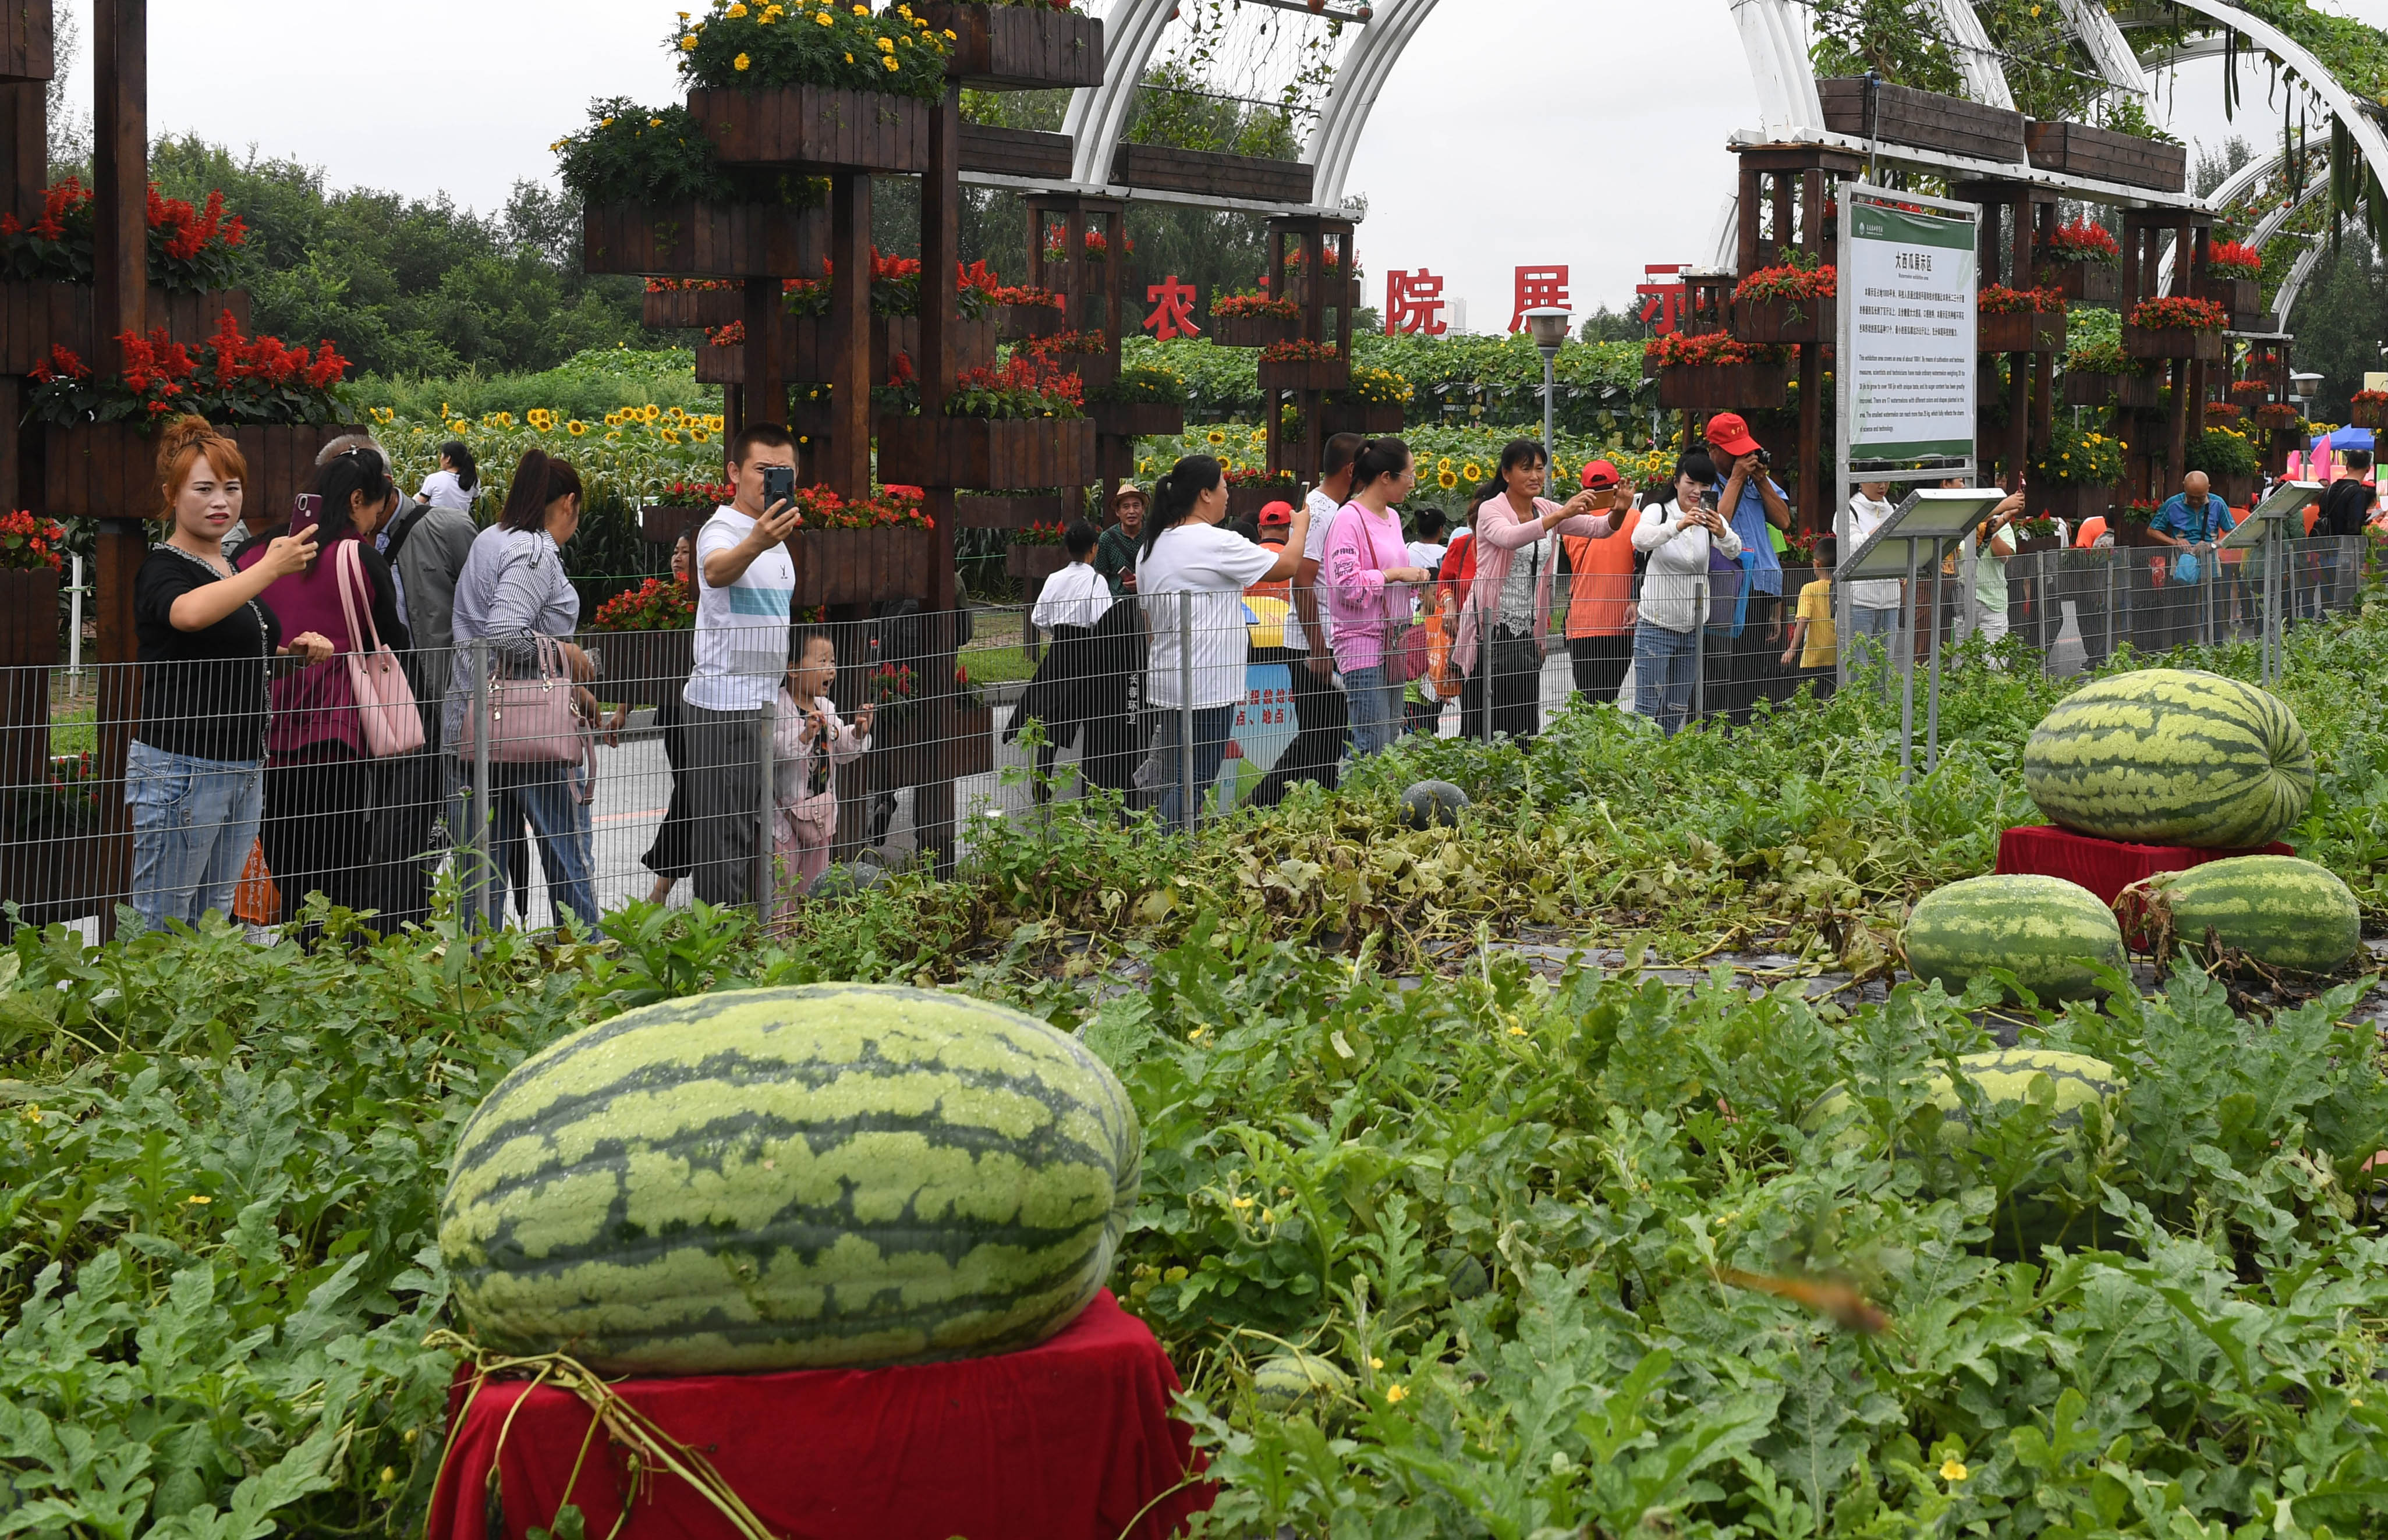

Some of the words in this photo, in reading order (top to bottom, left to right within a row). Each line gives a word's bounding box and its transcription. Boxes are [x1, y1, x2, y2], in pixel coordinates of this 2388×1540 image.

[1895, 251, 1932, 272] 大西瓜展示区
[1127, 673, 1138, 724] 长春环卫
